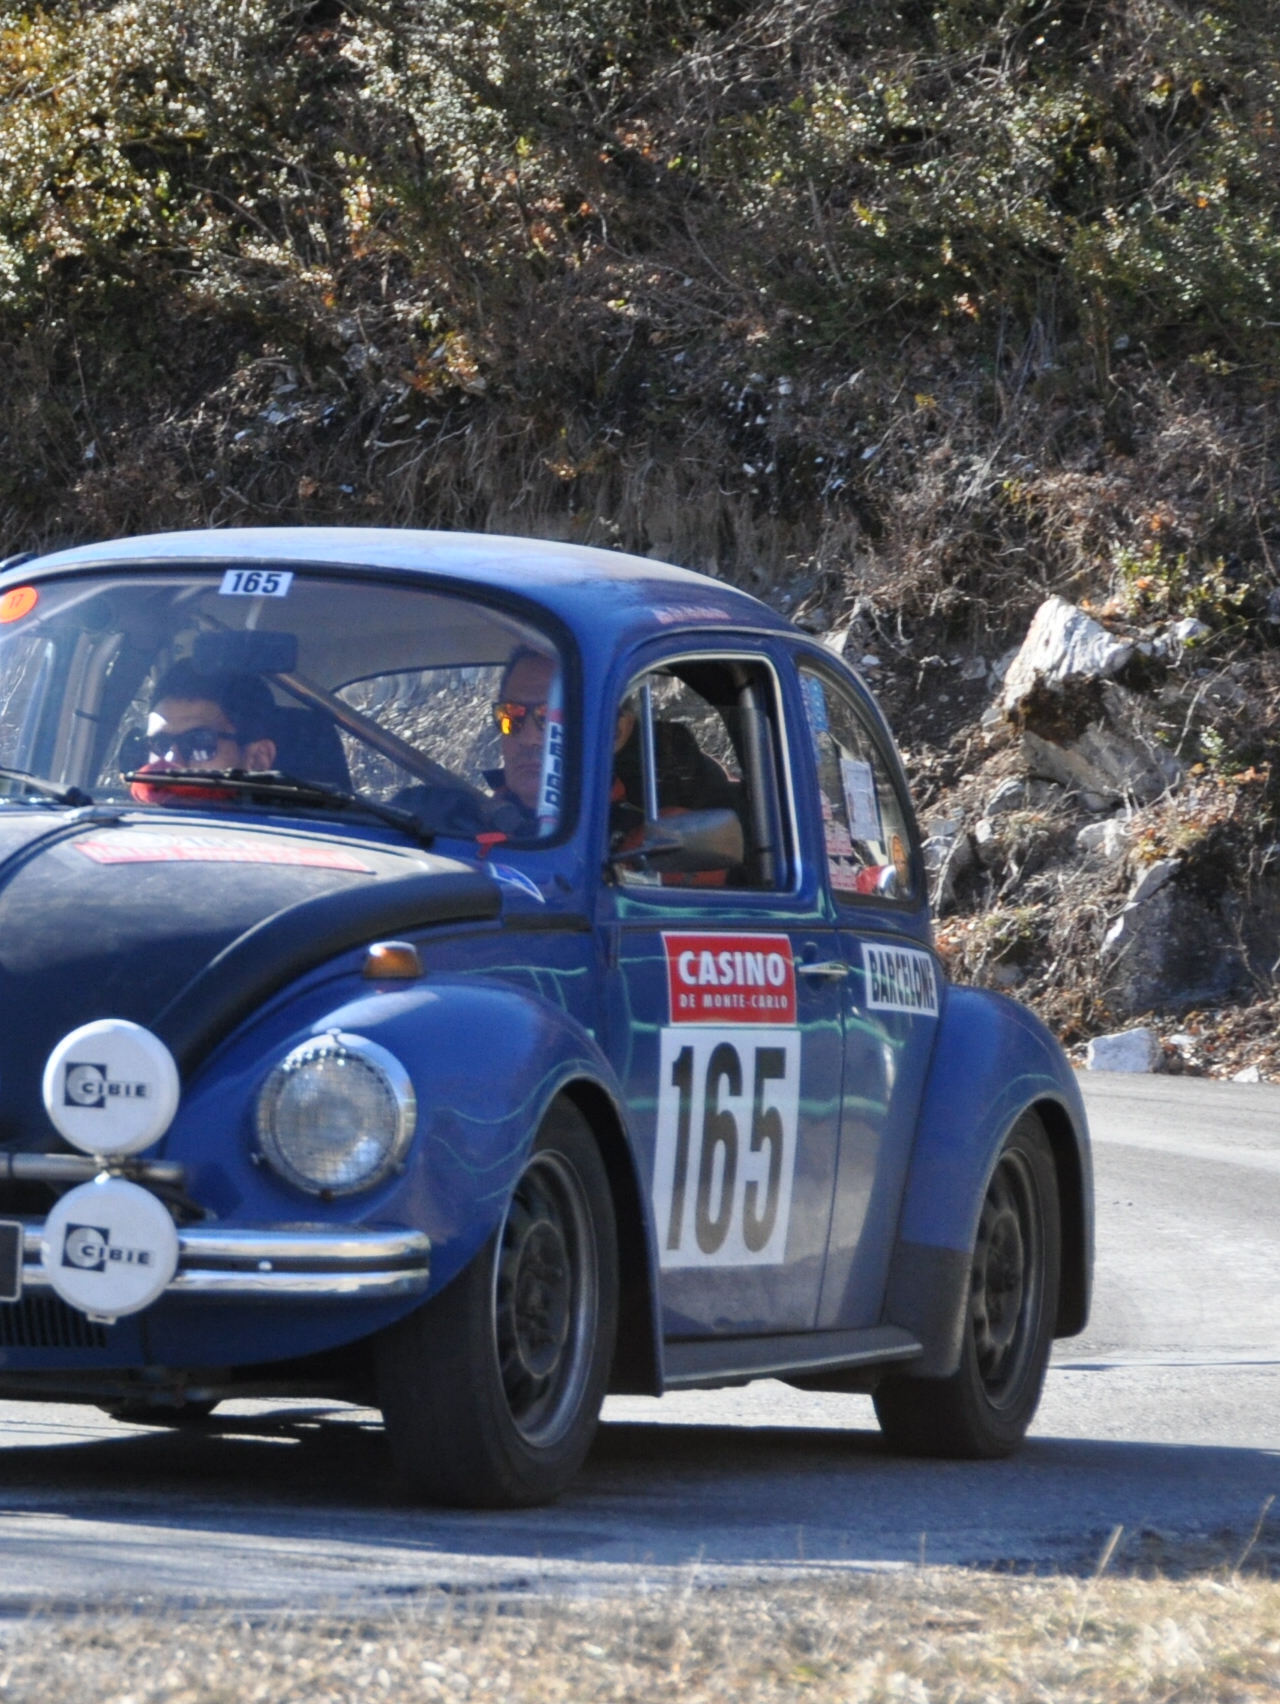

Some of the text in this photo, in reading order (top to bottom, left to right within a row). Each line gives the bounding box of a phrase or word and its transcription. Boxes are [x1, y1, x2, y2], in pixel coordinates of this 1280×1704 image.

[230, 571, 282, 594] 165
[678, 950, 787, 986] CASINO
[867, 949, 936, 1010] BARCELONE
[679, 993, 789, 1009] DE MONTE-CARLO
[81, 1081, 148, 1098] CIBIE
[666, 1042, 787, 1255] 165
[81, 1244, 150, 1266] CIBIE
